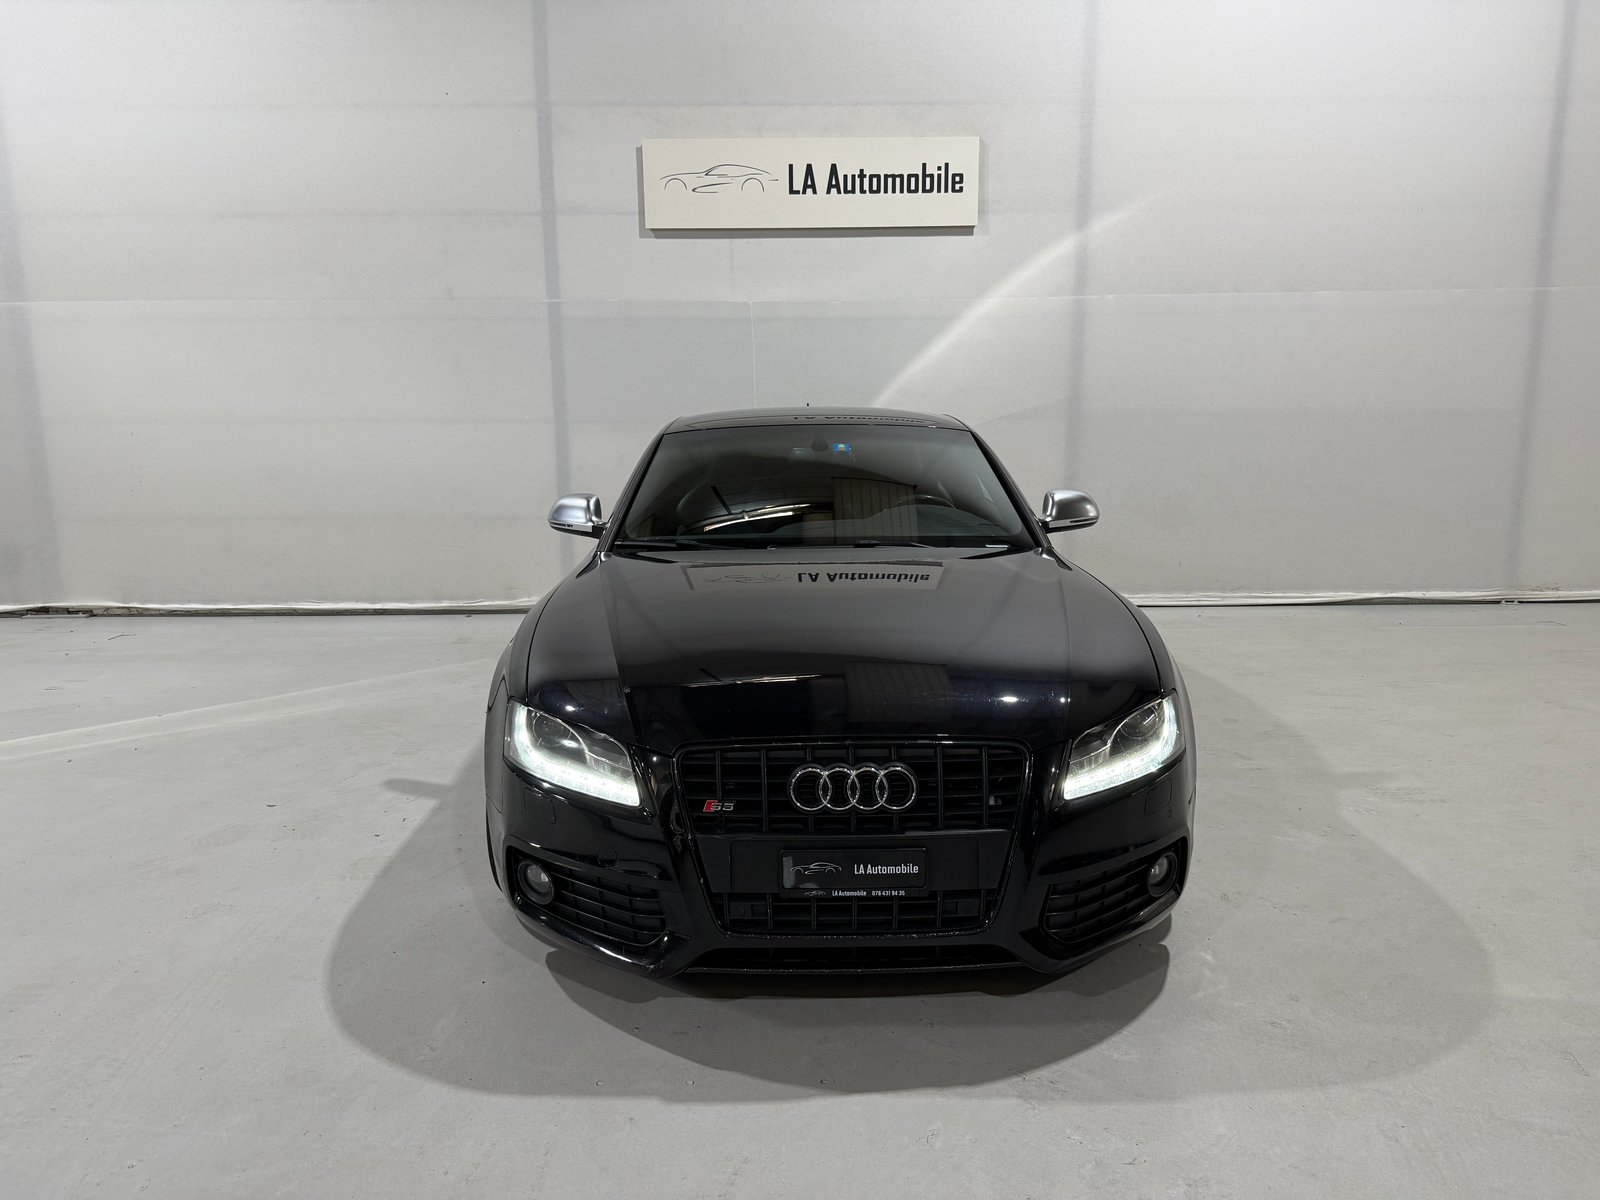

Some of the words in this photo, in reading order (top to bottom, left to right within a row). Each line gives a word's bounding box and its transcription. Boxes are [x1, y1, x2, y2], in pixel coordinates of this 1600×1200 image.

[788, 163, 818, 195] LA
[826, 162, 964, 195] Automobile
[854, 864, 865, 875] LA
[866, 863, 919, 875] Automobile
